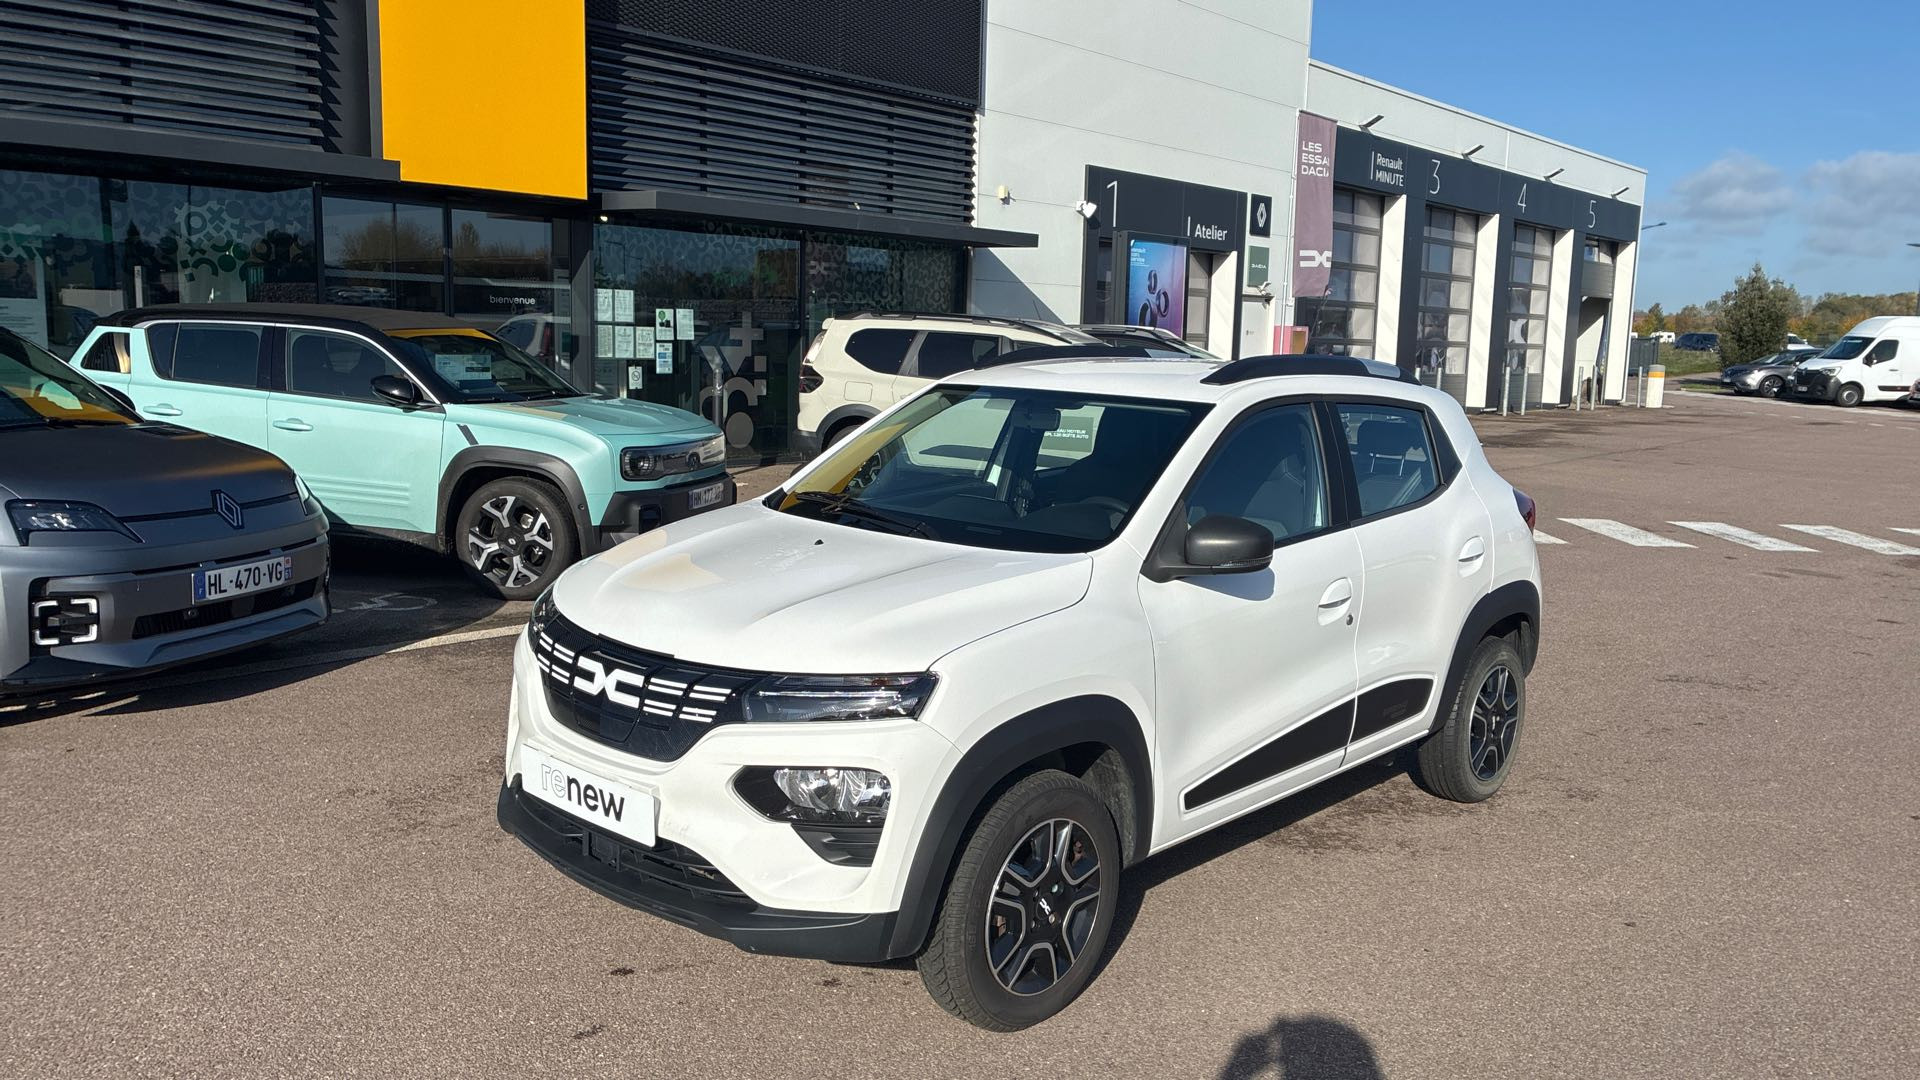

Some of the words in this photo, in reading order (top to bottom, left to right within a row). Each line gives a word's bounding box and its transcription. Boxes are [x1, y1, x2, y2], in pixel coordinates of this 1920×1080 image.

[1302, 140, 1323, 153] LES
[1376, 153, 1403, 171] Renault
[1429, 159, 1441, 195] 3
[1375, 169, 1405, 187] MINUTE
[1106, 180, 1118, 228] 1
[1517, 183, 1527, 214] 4
[1587, 199, 1597, 229] 5
[1194, 223, 1228, 241] Atelier
[489, 294, 536, 305] bienvenue
[208, 561, 283, 596] HL-470-VG
[541, 763, 625, 822] renew
